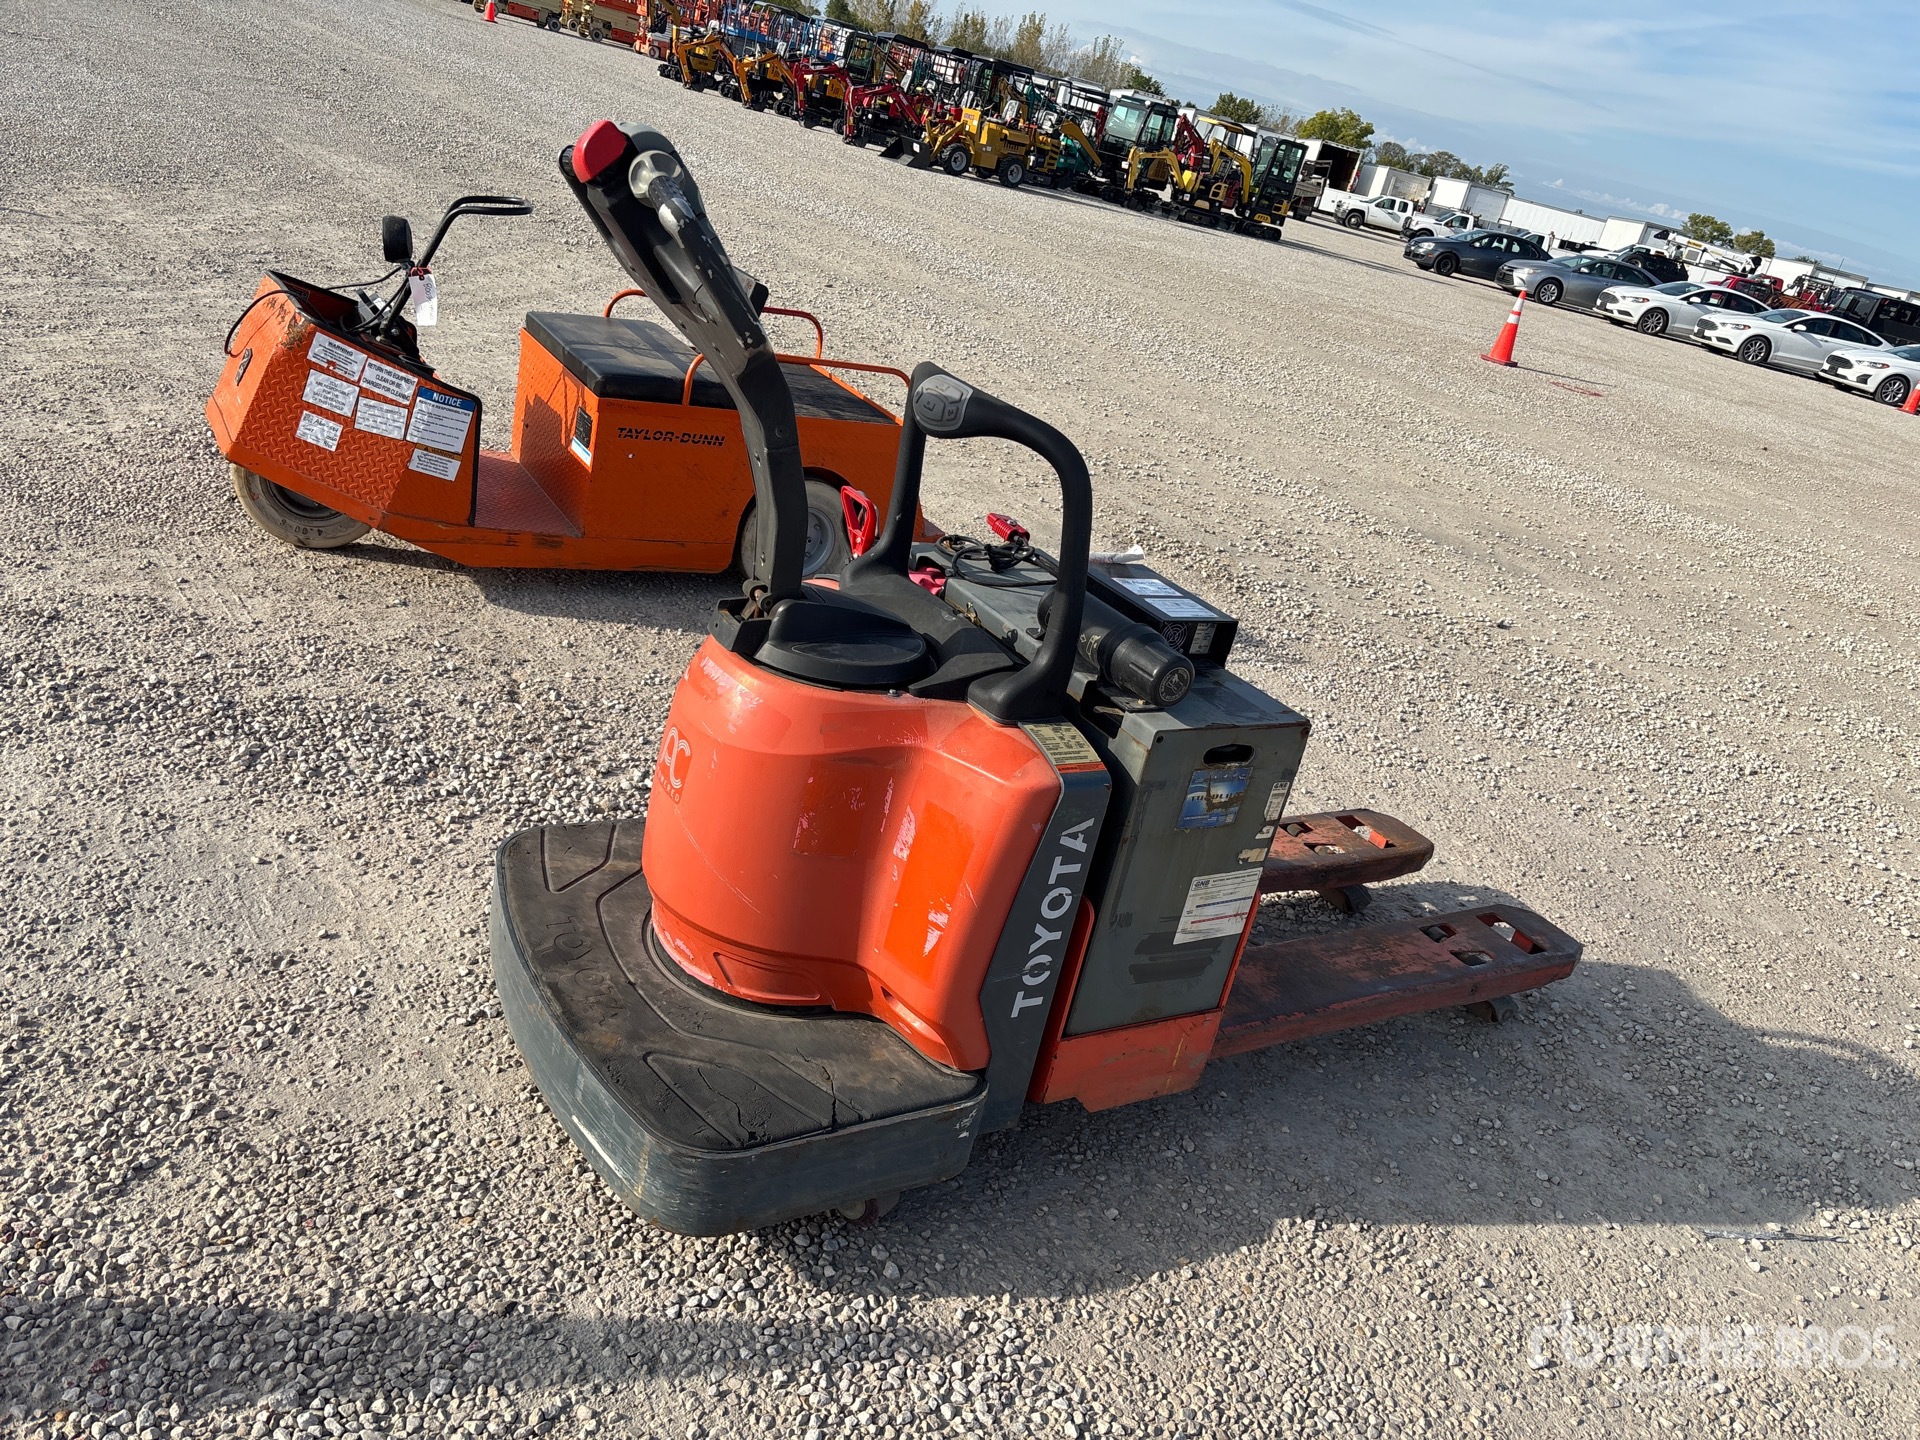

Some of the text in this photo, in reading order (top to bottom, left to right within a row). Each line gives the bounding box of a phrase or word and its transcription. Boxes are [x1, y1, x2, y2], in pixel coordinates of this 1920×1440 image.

[327, 340, 353, 356] WARNING
[367, 362, 415, 385] RETURN THIS EQUIPMENT
[375, 373, 389, 383] CLEAN
[362, 377, 382, 389] CHARGED
[432, 392, 462, 407] NOTICE
[617, 427, 725, 447] TAYLOR-DUNN
[1194, 880, 1211, 888] GNB
[1010, 817, 1095, 1018] TOYOTA
